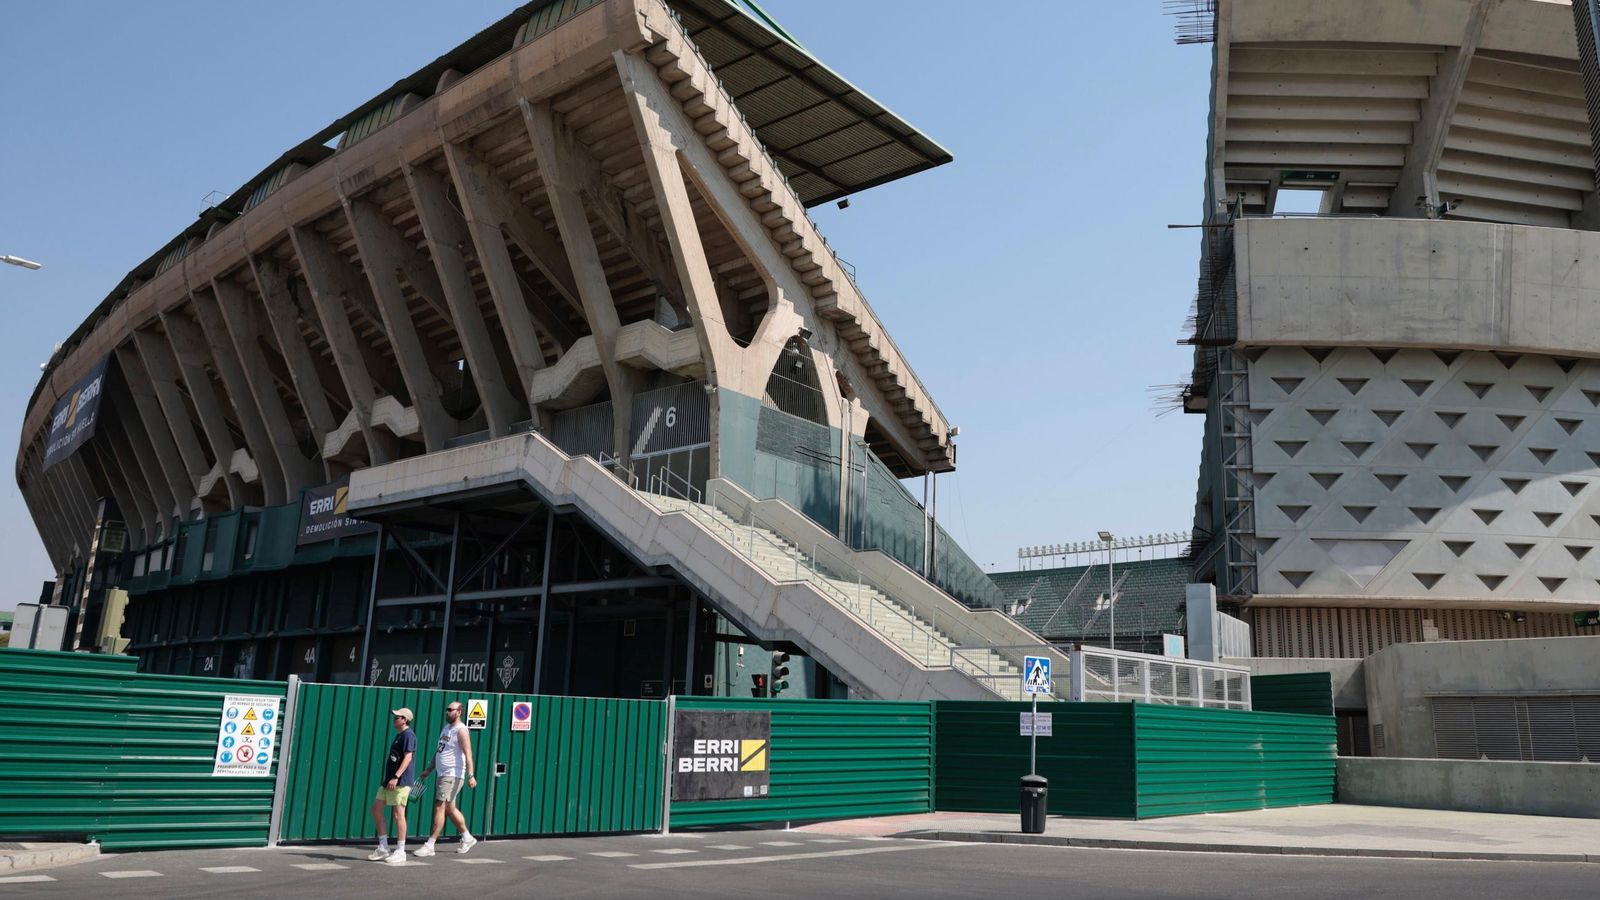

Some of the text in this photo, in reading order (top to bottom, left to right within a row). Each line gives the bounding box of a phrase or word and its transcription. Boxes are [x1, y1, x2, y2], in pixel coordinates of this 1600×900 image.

[666, 406, 676, 428] 6
[310, 495, 334, 515] ERRI
[306, 518, 342, 534] DEMOLICIÓN
[304, 647, 315, 664] 4A
[350, 647, 356, 662] 4
[204, 656, 214, 671] 2A
[388, 659, 436, 682] ATENCIÓN
[693, 739, 739, 754] ERRI
[678, 757, 739, 773] BERRI
